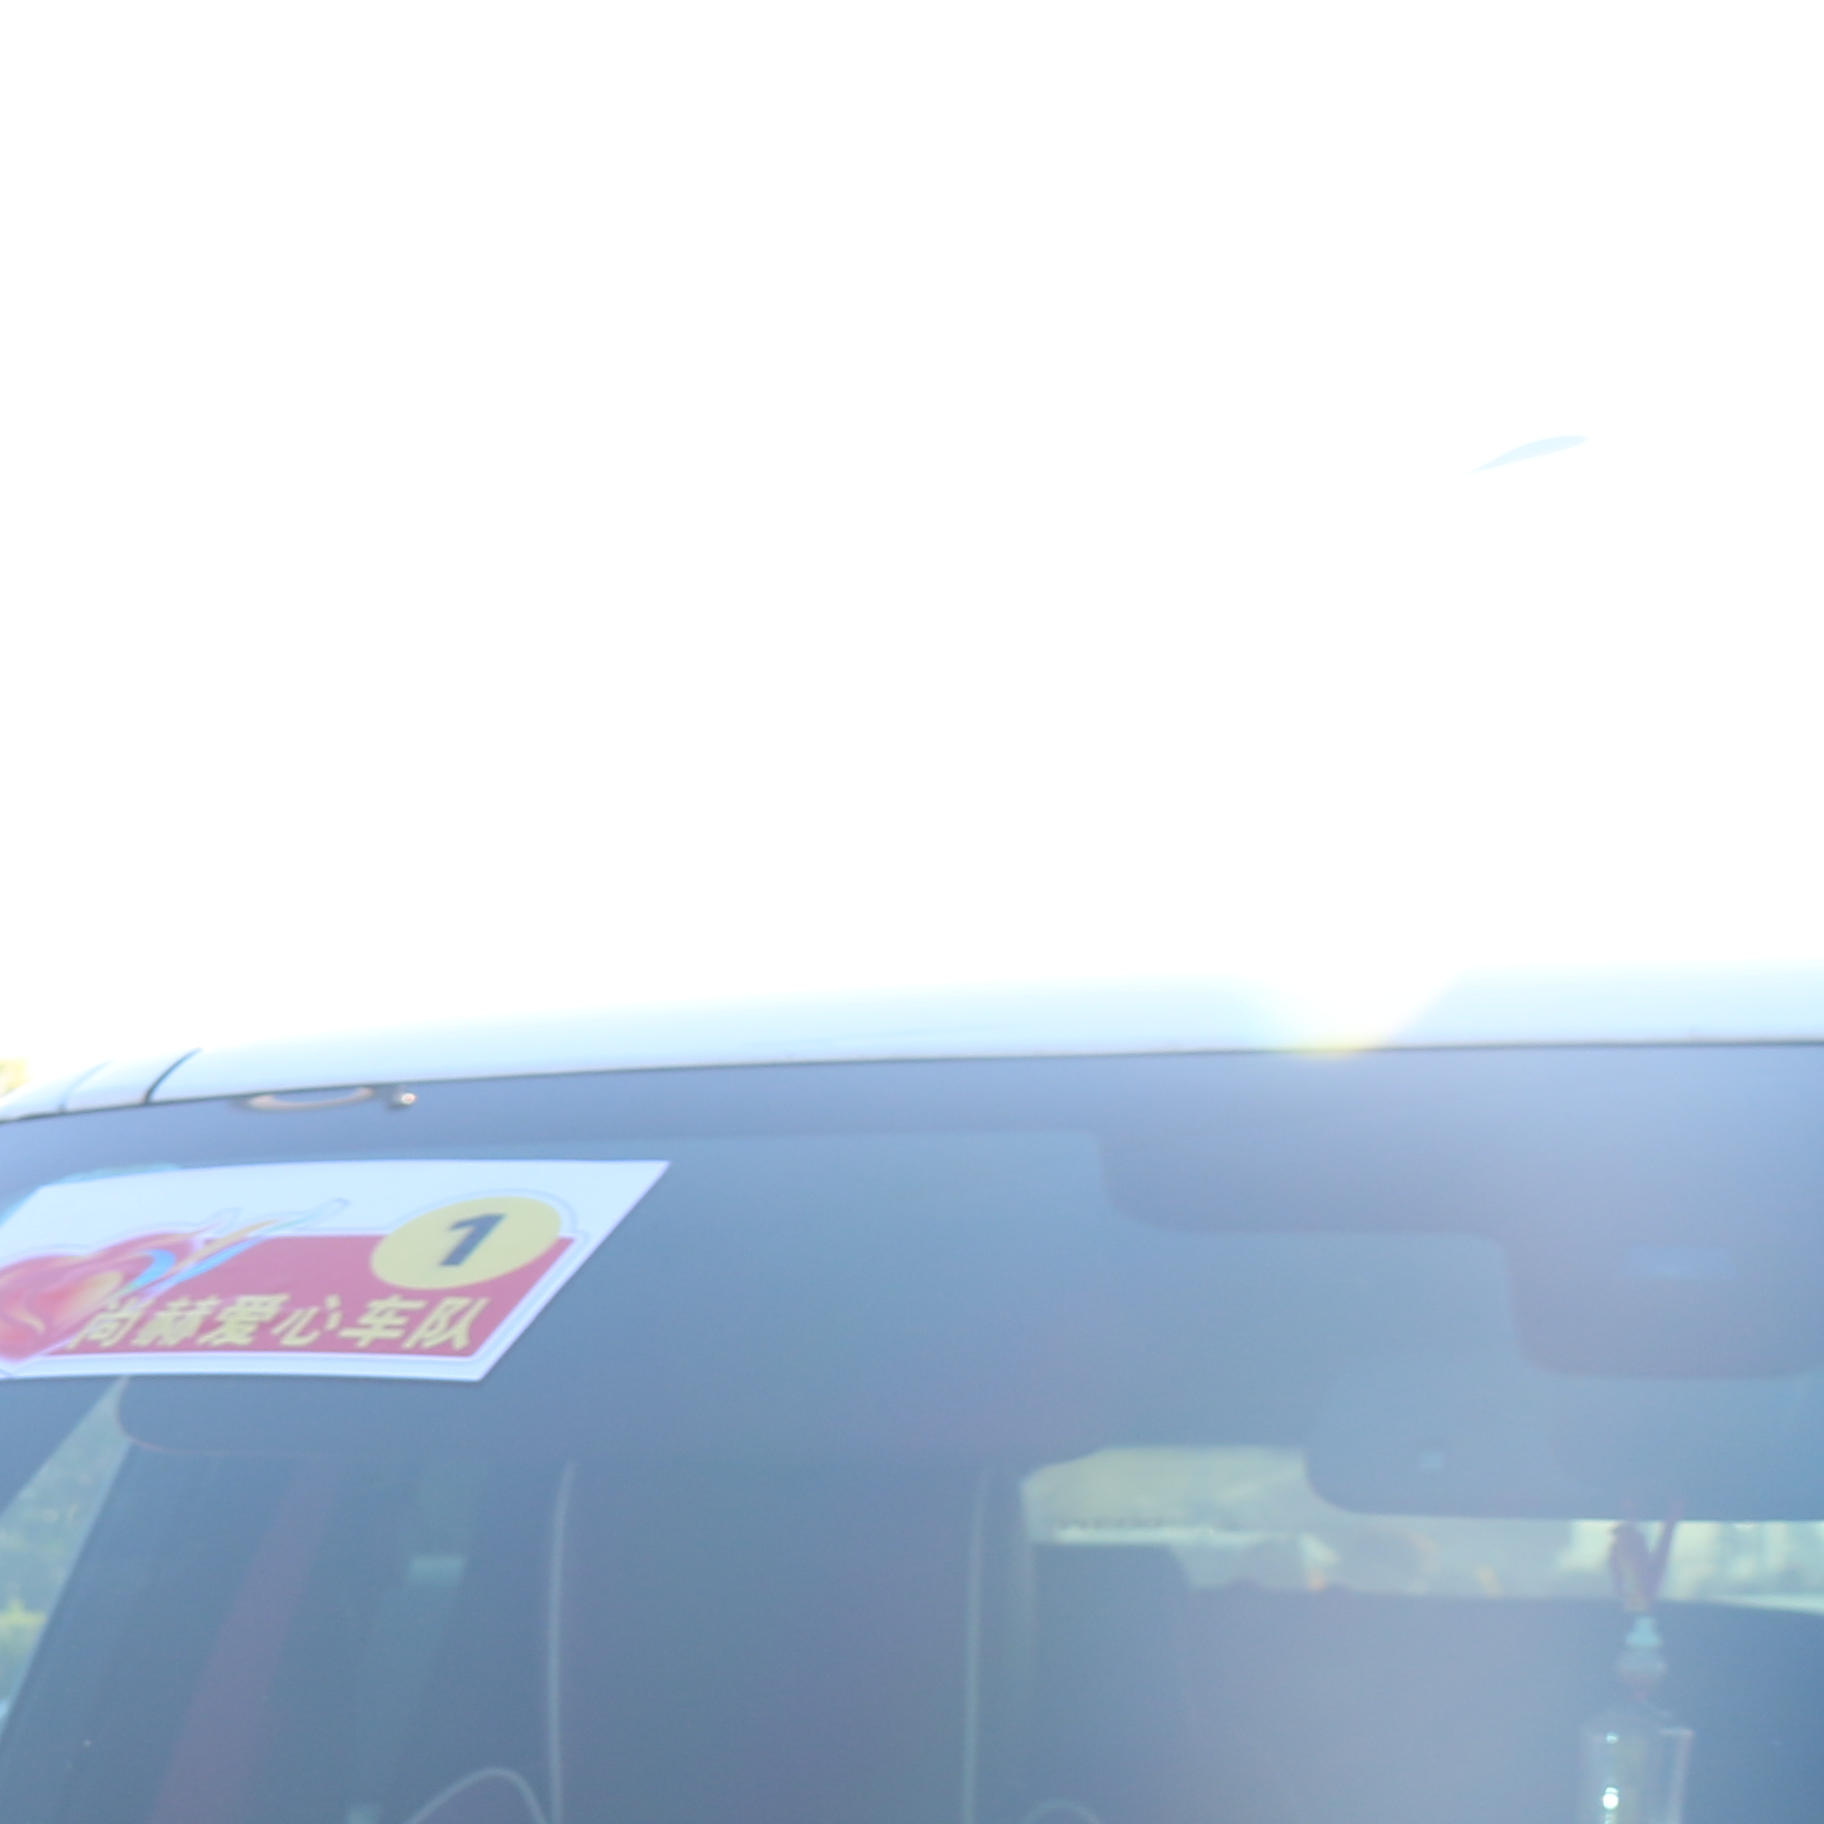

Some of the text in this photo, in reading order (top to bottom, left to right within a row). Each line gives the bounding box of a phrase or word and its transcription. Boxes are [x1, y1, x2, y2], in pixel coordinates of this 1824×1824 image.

[439, 1213, 507, 1267] 1
[65, 1292, 489, 1349] 尚赫爱心车队
